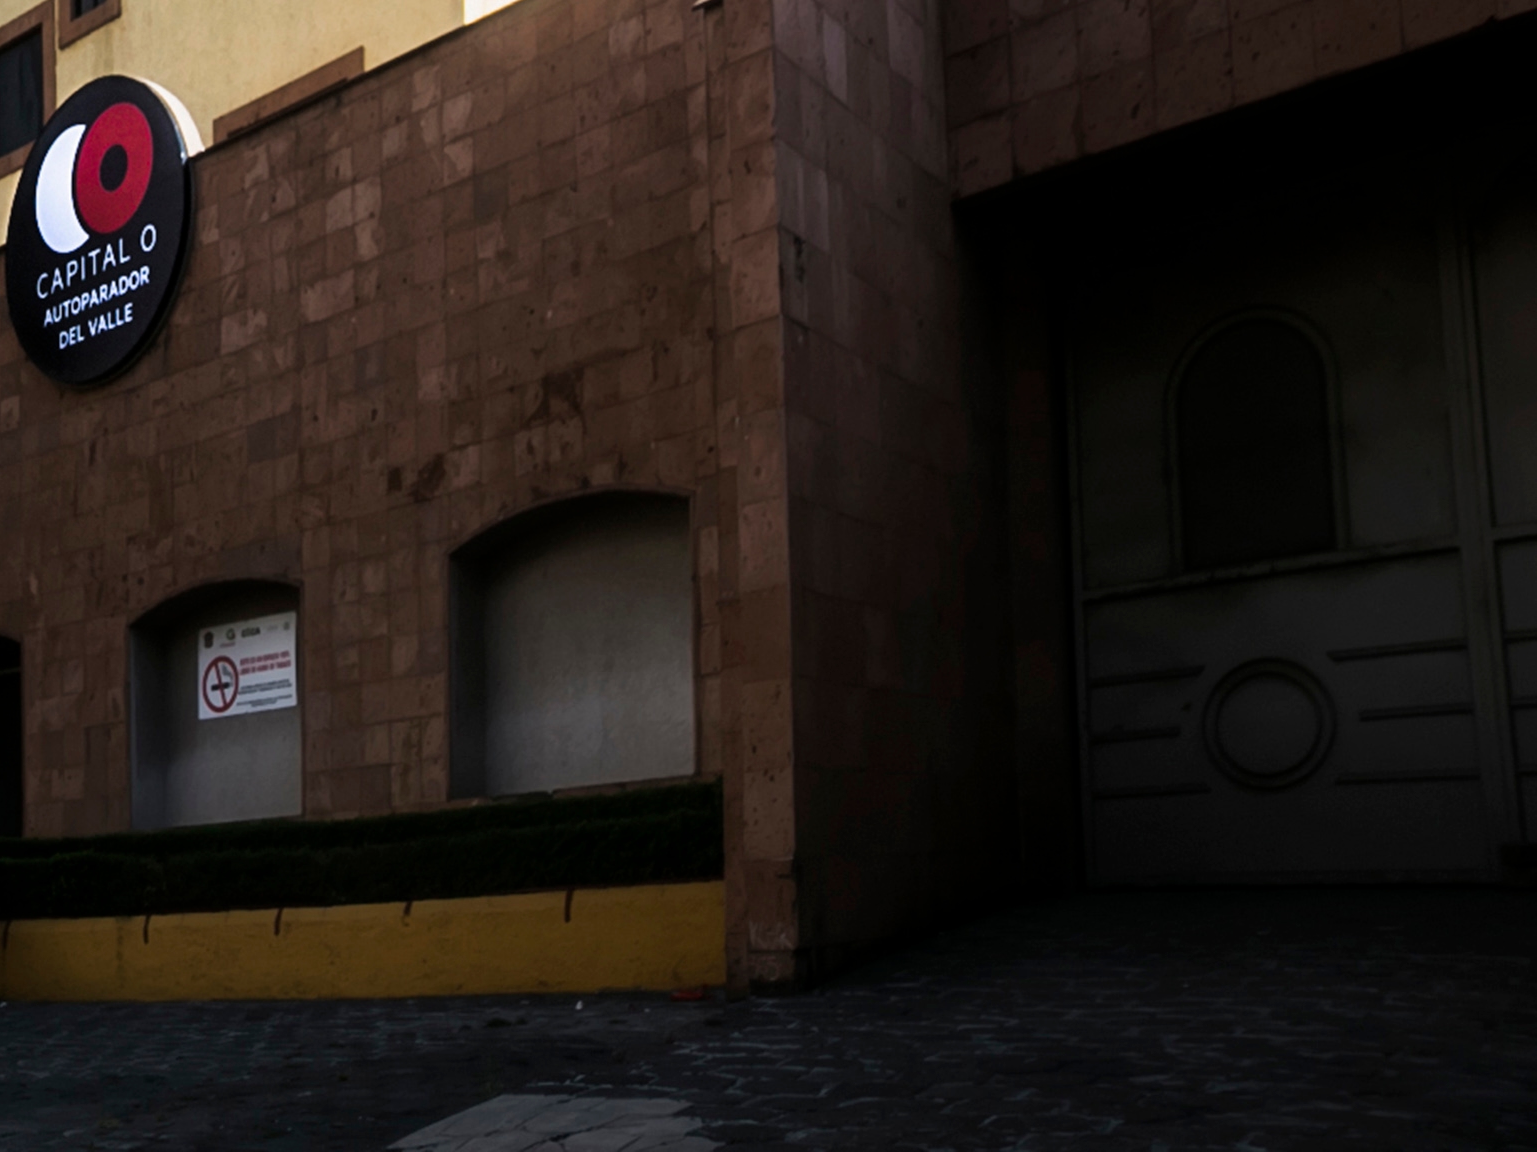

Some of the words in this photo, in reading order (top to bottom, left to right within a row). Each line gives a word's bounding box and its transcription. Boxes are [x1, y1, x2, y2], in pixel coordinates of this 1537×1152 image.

[36, 238, 131, 299] CAPITAL
[140, 224, 157, 252] O
[43, 265, 150, 327] AUTOPARADOR
[59, 325, 85, 350] DEL
[88, 302, 134, 337] VALLE
